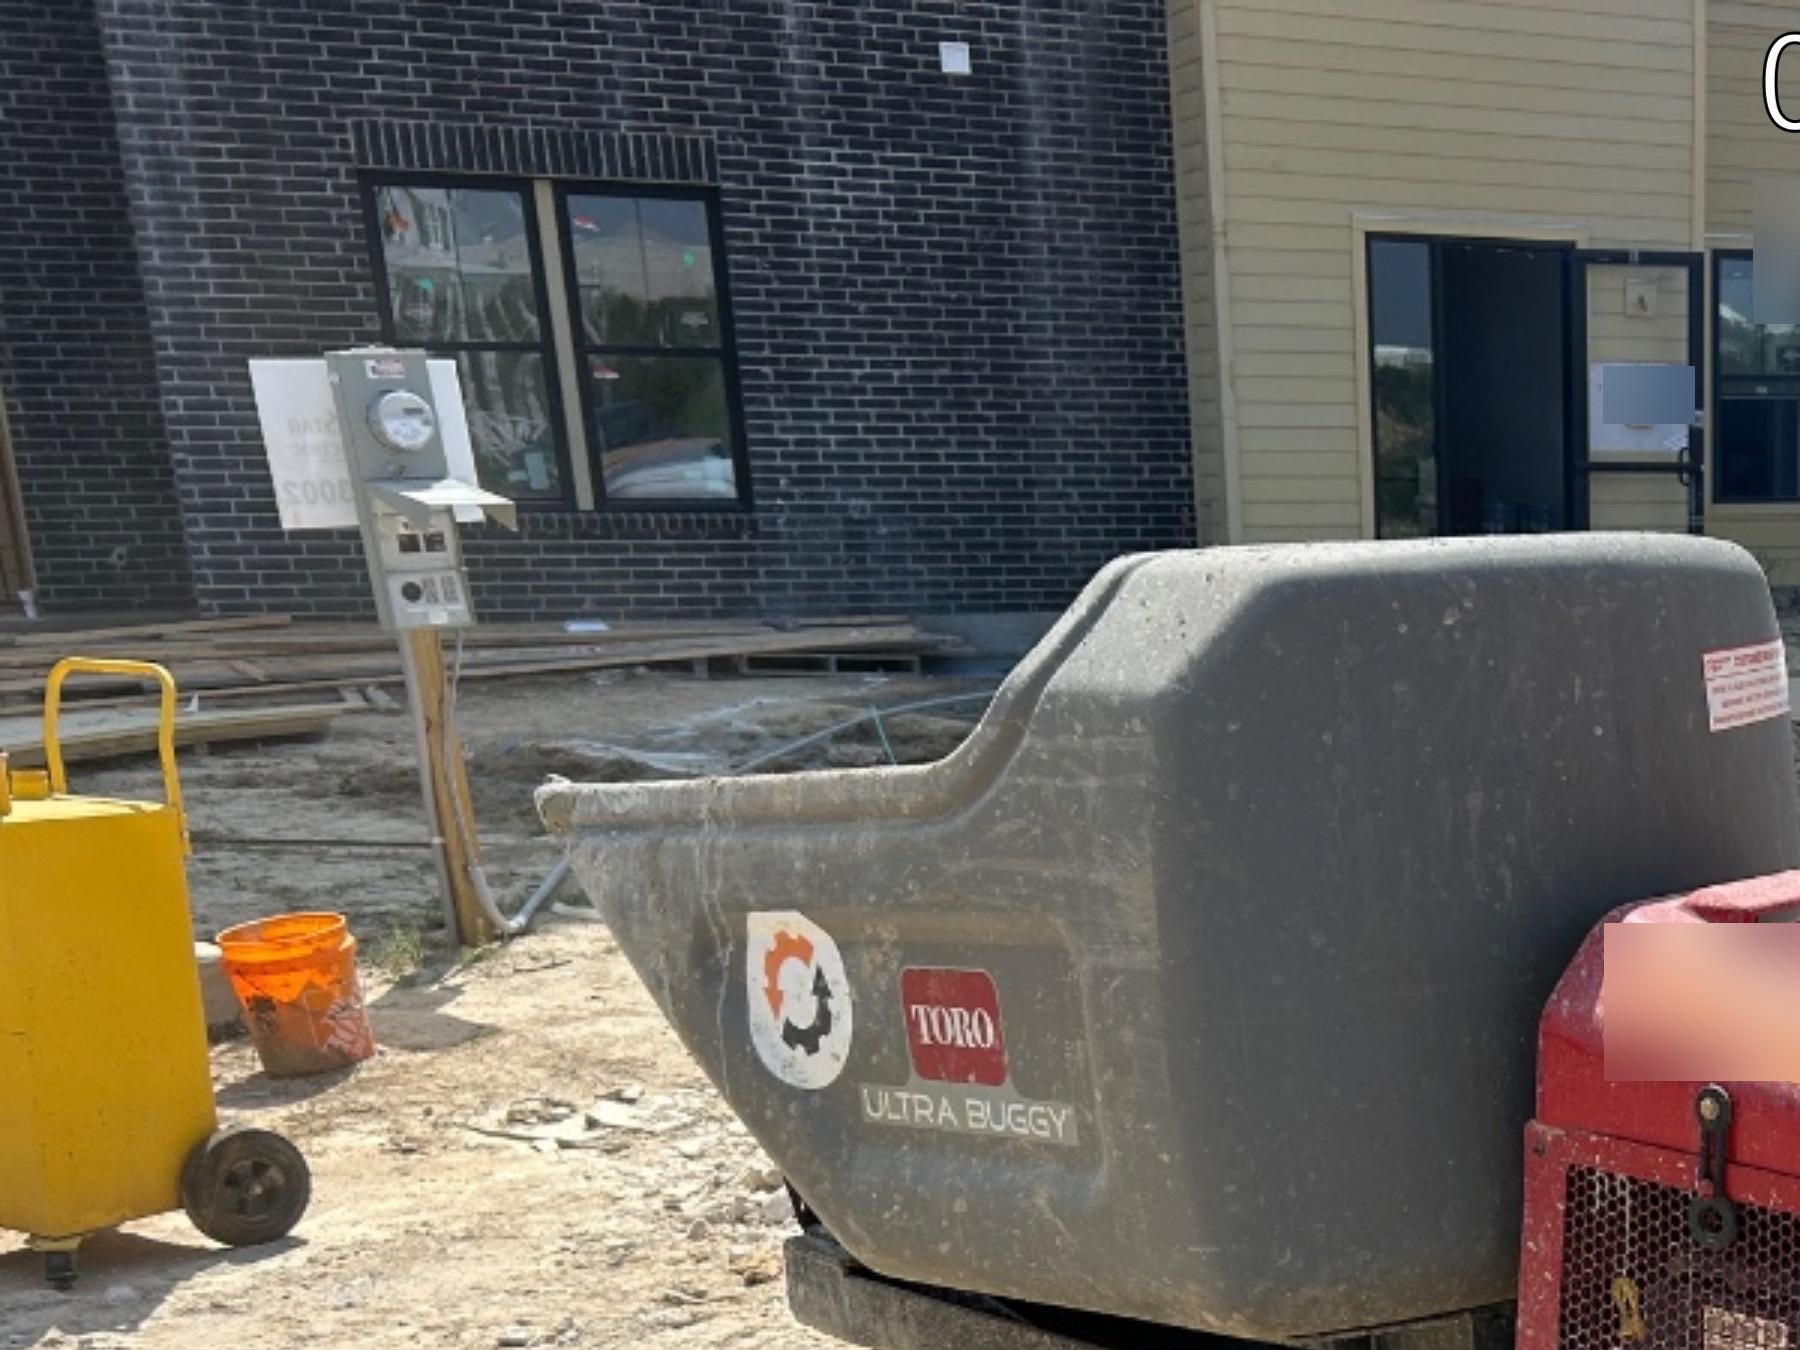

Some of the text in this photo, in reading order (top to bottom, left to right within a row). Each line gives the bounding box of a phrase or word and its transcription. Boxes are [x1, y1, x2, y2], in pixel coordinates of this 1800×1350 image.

[910, 1003, 995, 1049] TORO
[862, 1087, 1067, 1138] ULTRA BUGGY
